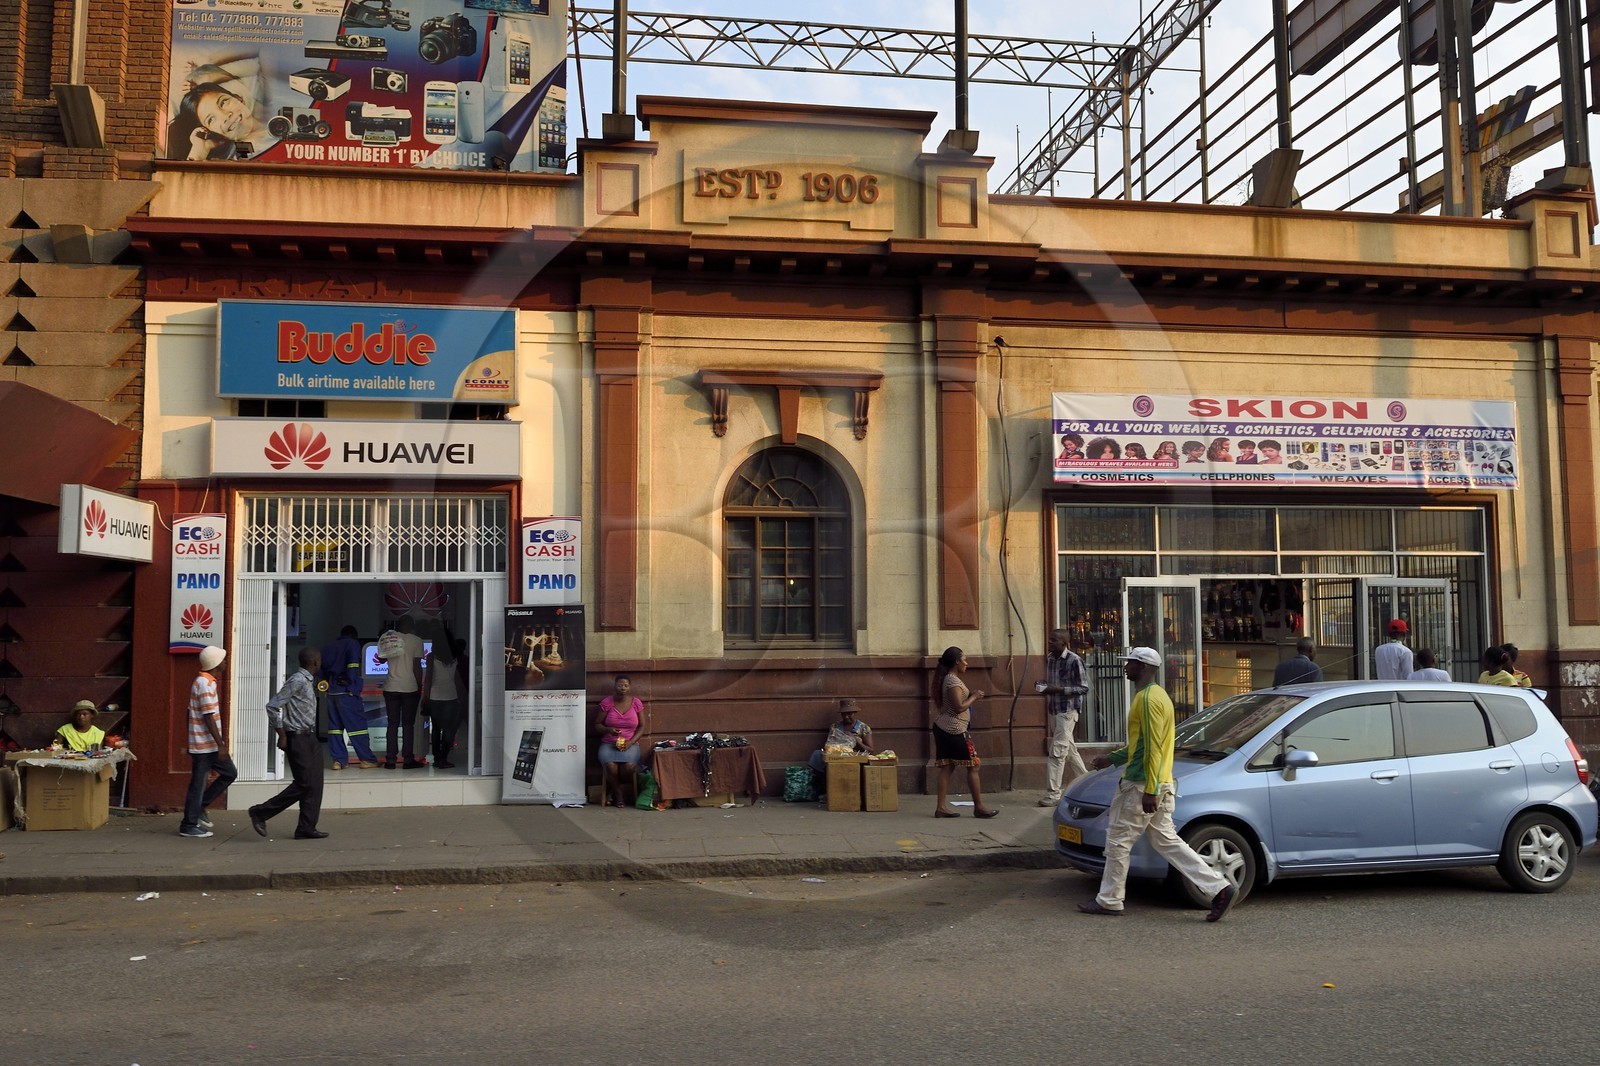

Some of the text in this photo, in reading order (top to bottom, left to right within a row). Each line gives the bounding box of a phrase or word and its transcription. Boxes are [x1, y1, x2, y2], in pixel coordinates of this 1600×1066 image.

[179, 11, 198, 23] Tel:
[220, 13, 262, 25] 777980,
[265, 16, 304, 27] 777983
[285, 143, 325, 160] YOUR
[328, 146, 390, 163] NUMBER
[410, 150, 429, 164] BY
[432, 151, 486, 167] CHOICE
[802, 172, 880, 204] 1906
[278, 320, 437, 365] Buddie
[277, 373, 435, 391] Bulk airtime available here
[1188, 398, 1368, 419] SKION
[1061, 422, 1512, 440] FOR ALL YOUR WEAVES, COSMETICS, CELLPHONES & ACCESSORIES
[343, 442, 474, 465] HUAWEI
[1081, 473, 1155, 482] COSMETICS
[1200, 473, 1276, 482] CELLPHONES
[1320, 475, 1389, 483] WEAVES
[1428, 476, 1503, 485] ACCESSORIES
[110, 518, 151, 540] HUAWEI
[175, 543, 220, 555] CASH
[525, 545, 575, 557] CASH
[177, 573, 220, 589] PANO
[528, 574, 576, 590] PANO
[567, 744, 578, 752] P8
